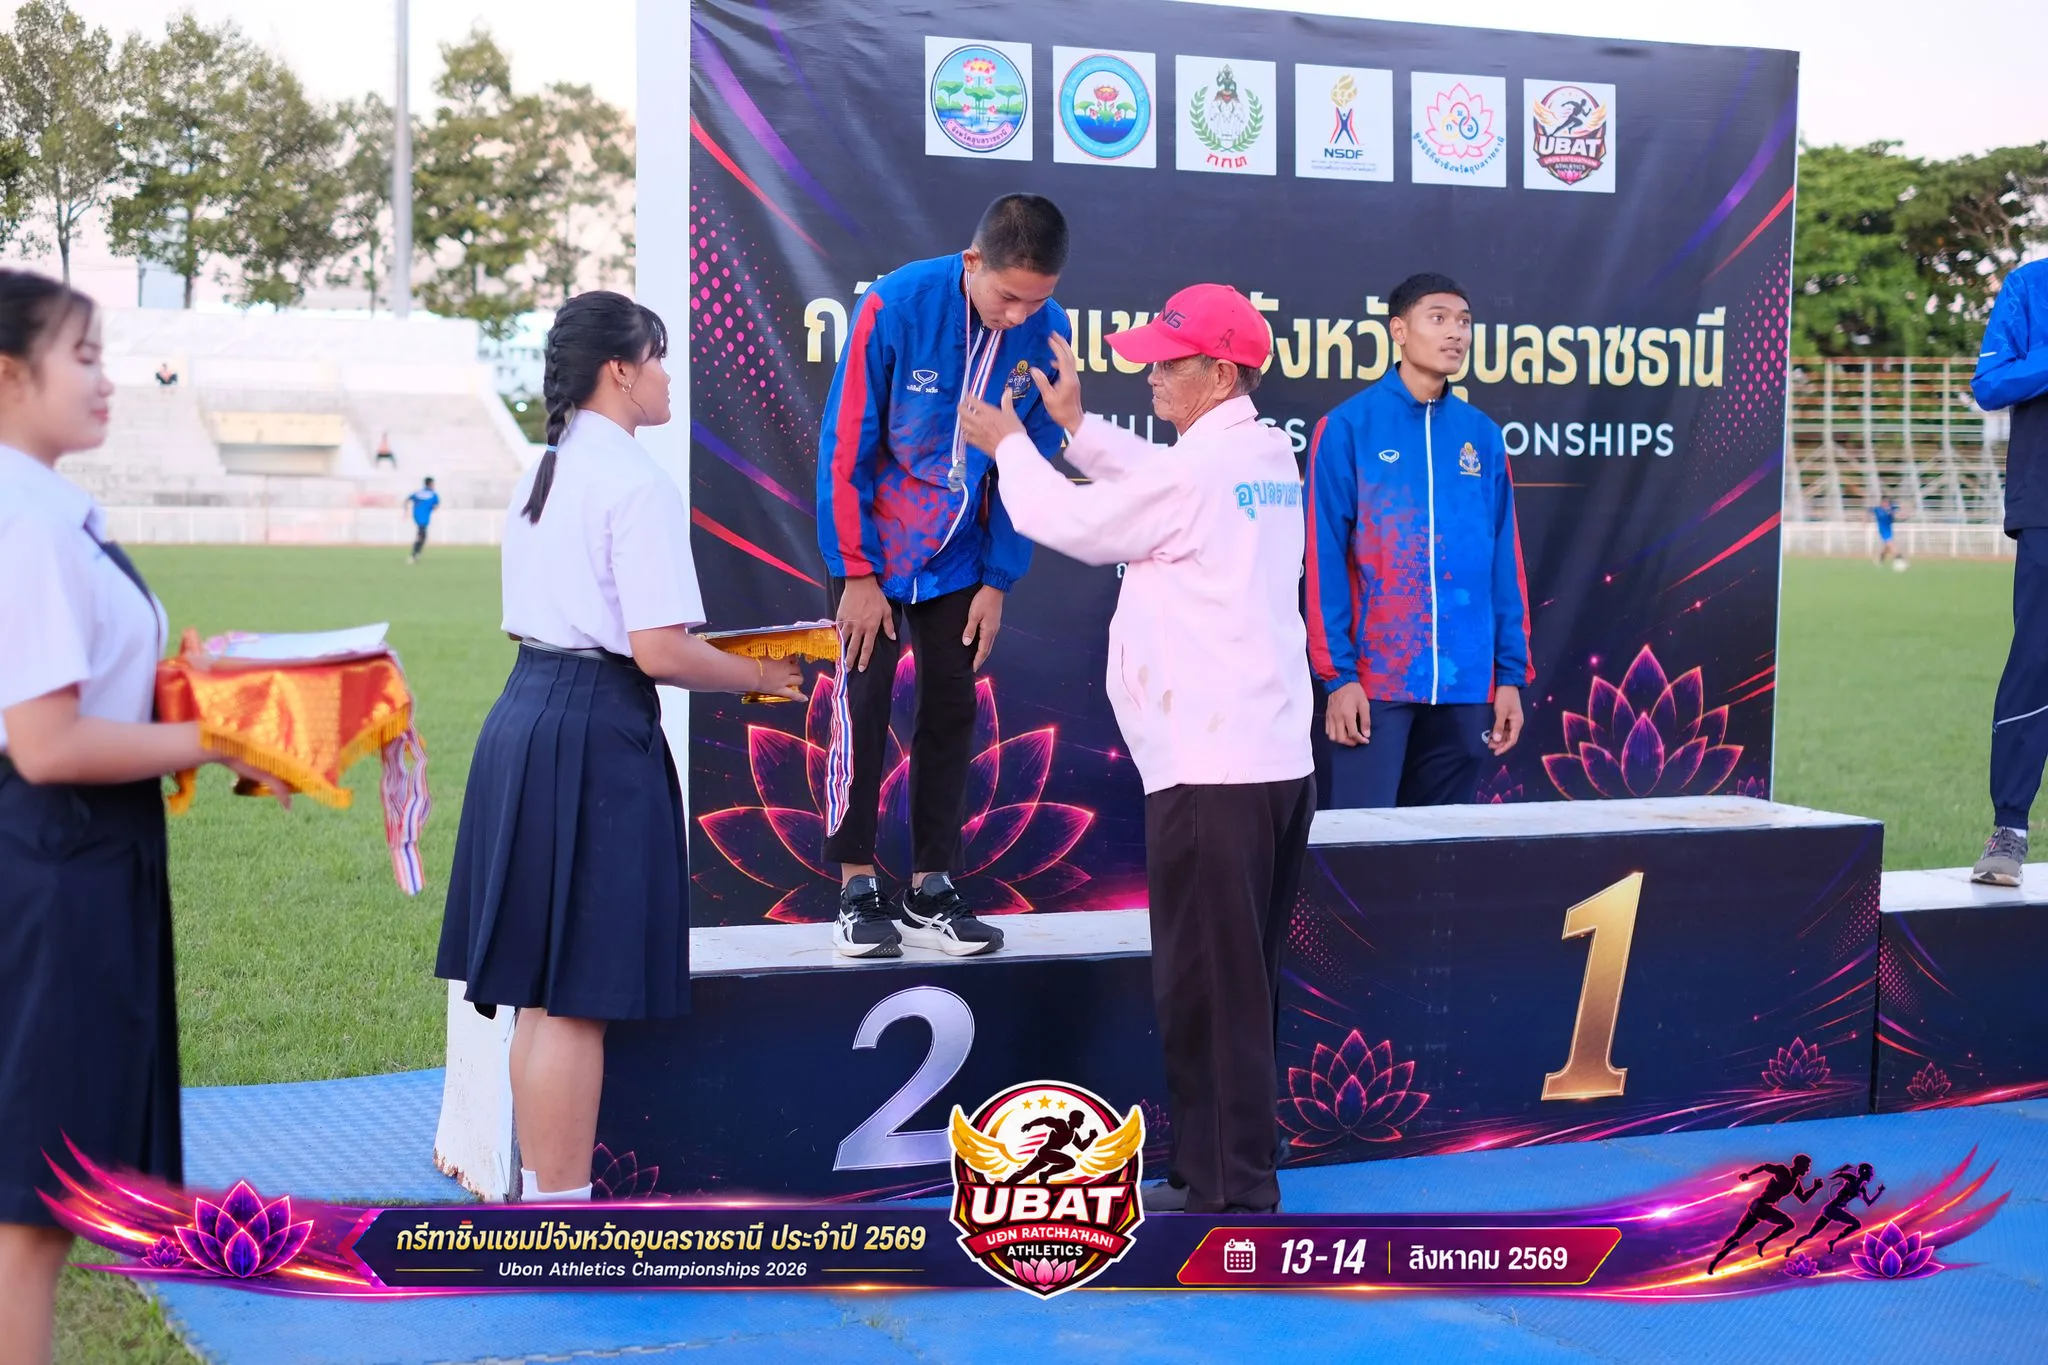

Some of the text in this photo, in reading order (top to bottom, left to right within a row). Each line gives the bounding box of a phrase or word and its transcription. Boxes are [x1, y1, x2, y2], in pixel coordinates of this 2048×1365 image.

[1324, 148, 1364, 159] NSDF
[1539, 135, 1601, 157] UBAT
[1501, 421, 1674, 457] ONSHIPS
[1541, 872, 1644, 1101] 1
[832, 985, 976, 1172] 2
